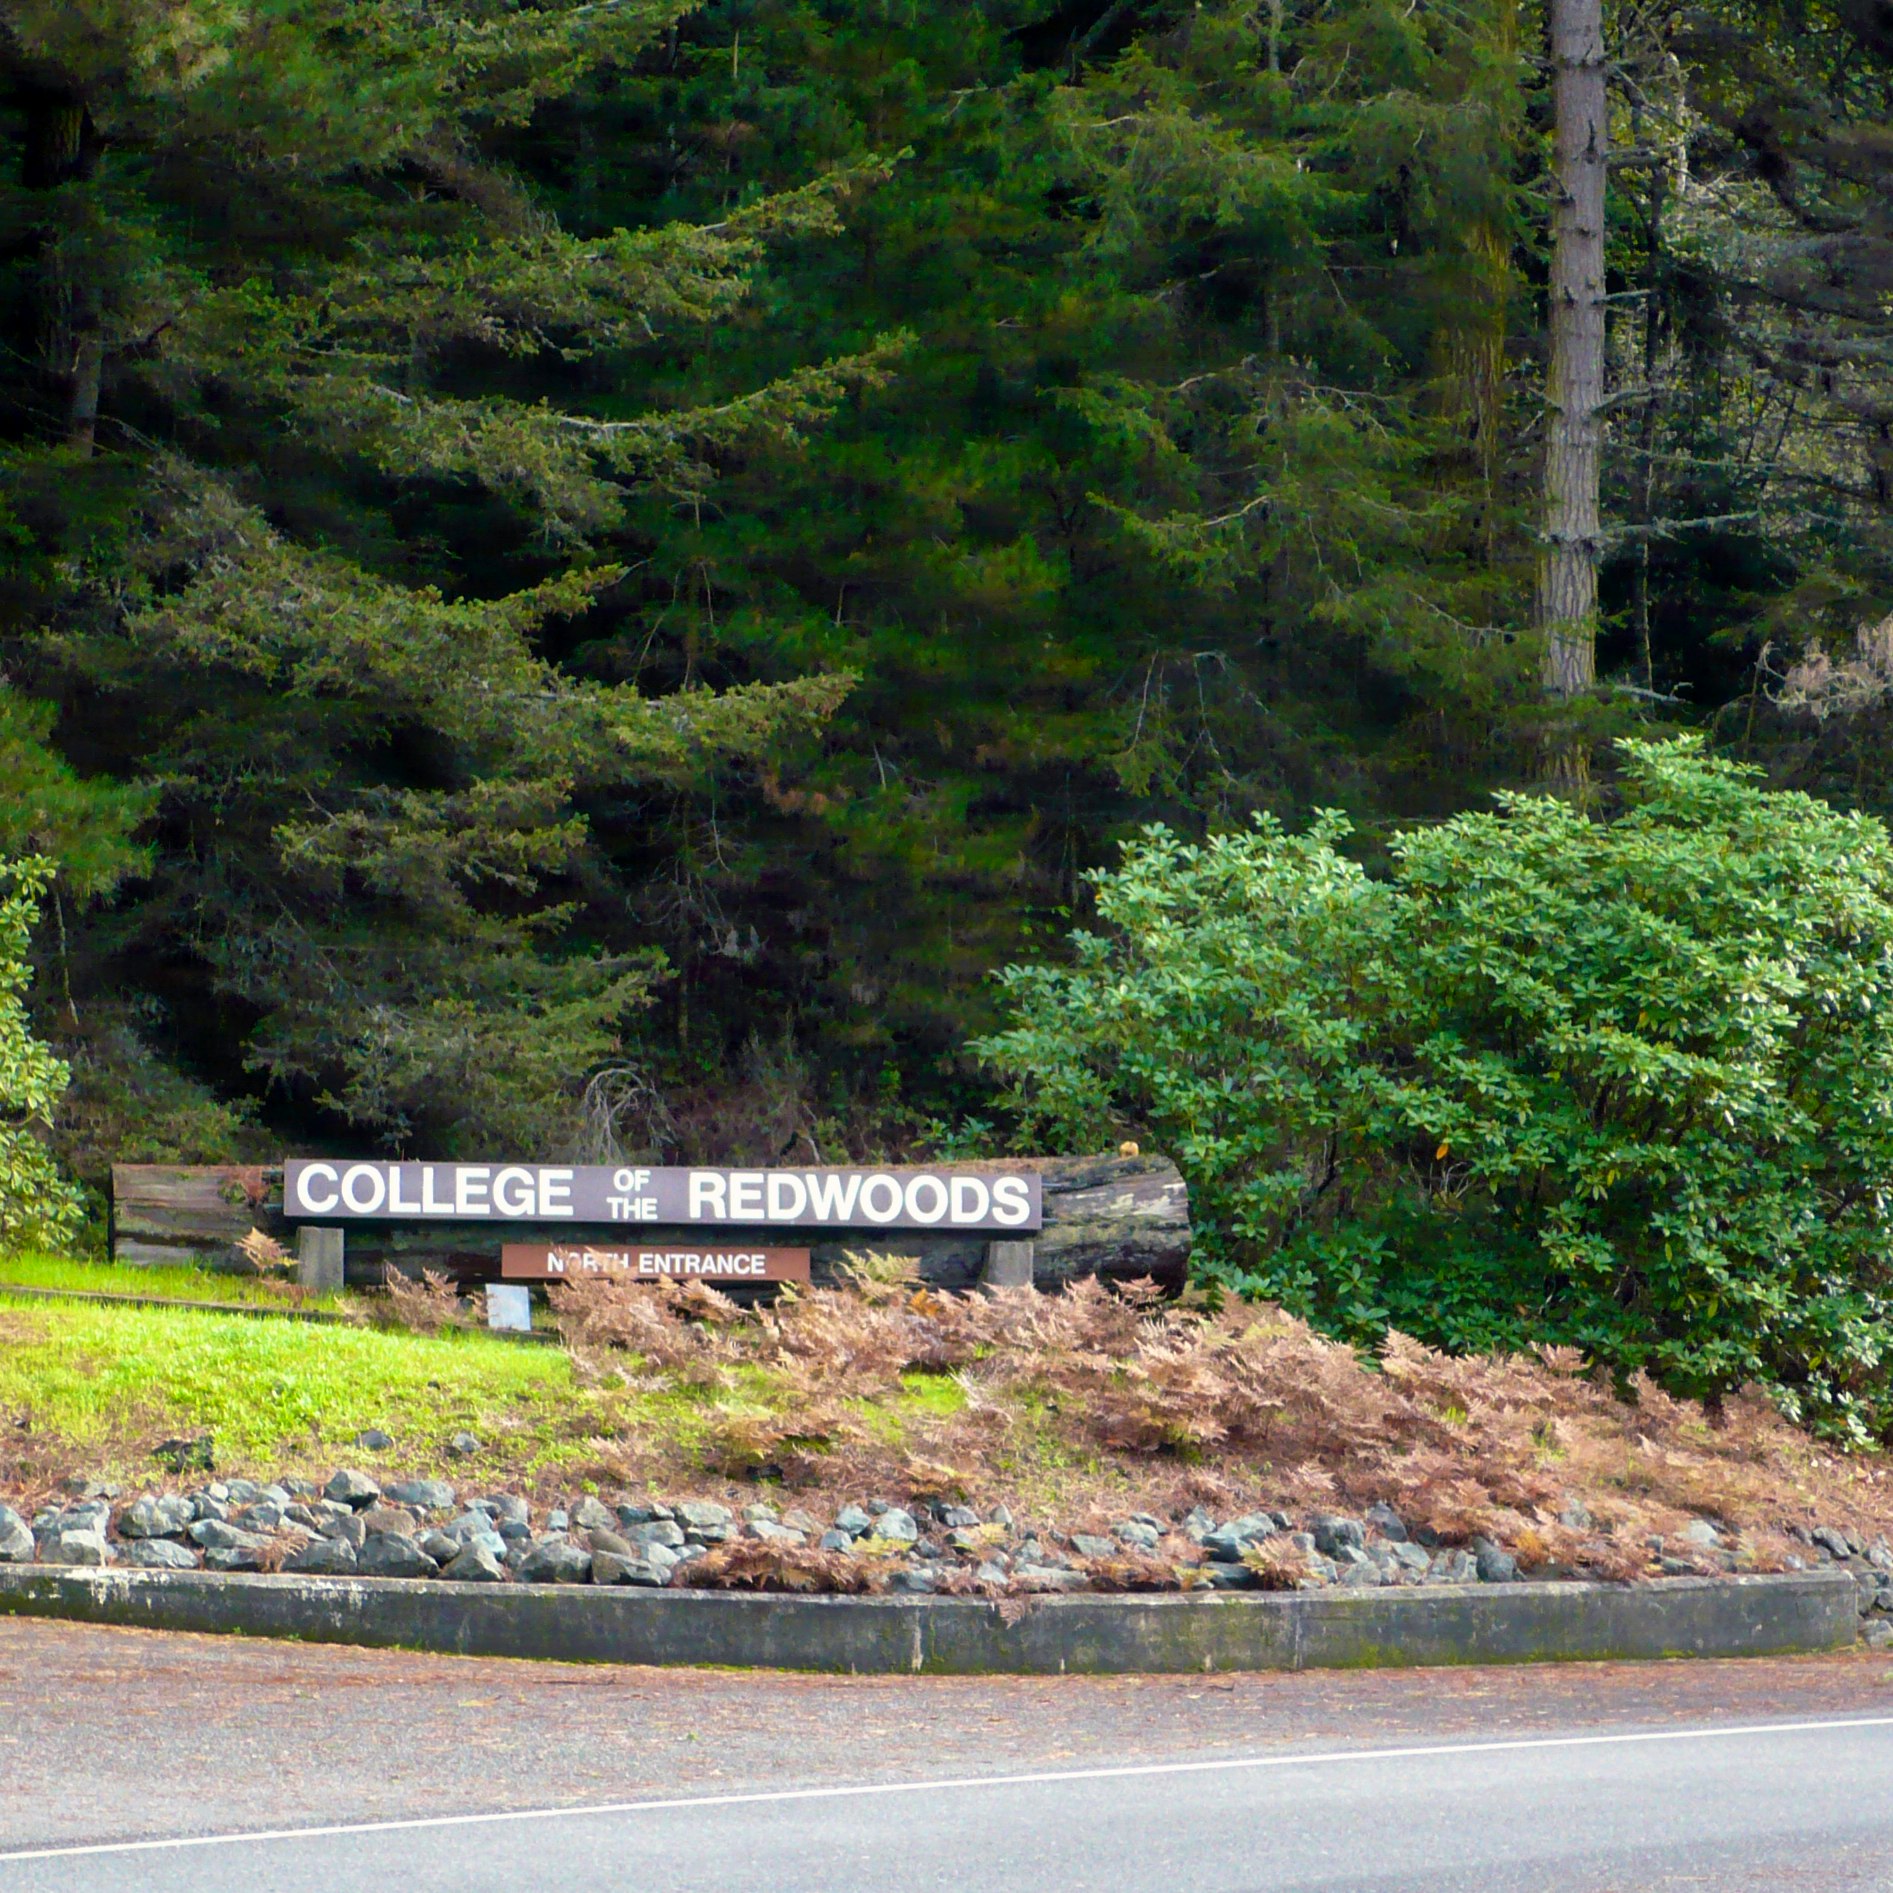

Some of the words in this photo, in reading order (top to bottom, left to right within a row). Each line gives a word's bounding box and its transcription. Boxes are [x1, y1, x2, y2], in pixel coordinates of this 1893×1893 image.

[297, 1163, 574, 1217] COLLEGE
[613, 1169, 651, 1192] OF
[606, 1197, 658, 1220] THE
[688, 1171, 1031, 1225] REDWOODS
[638, 1253, 766, 1274] ENTRANCE
